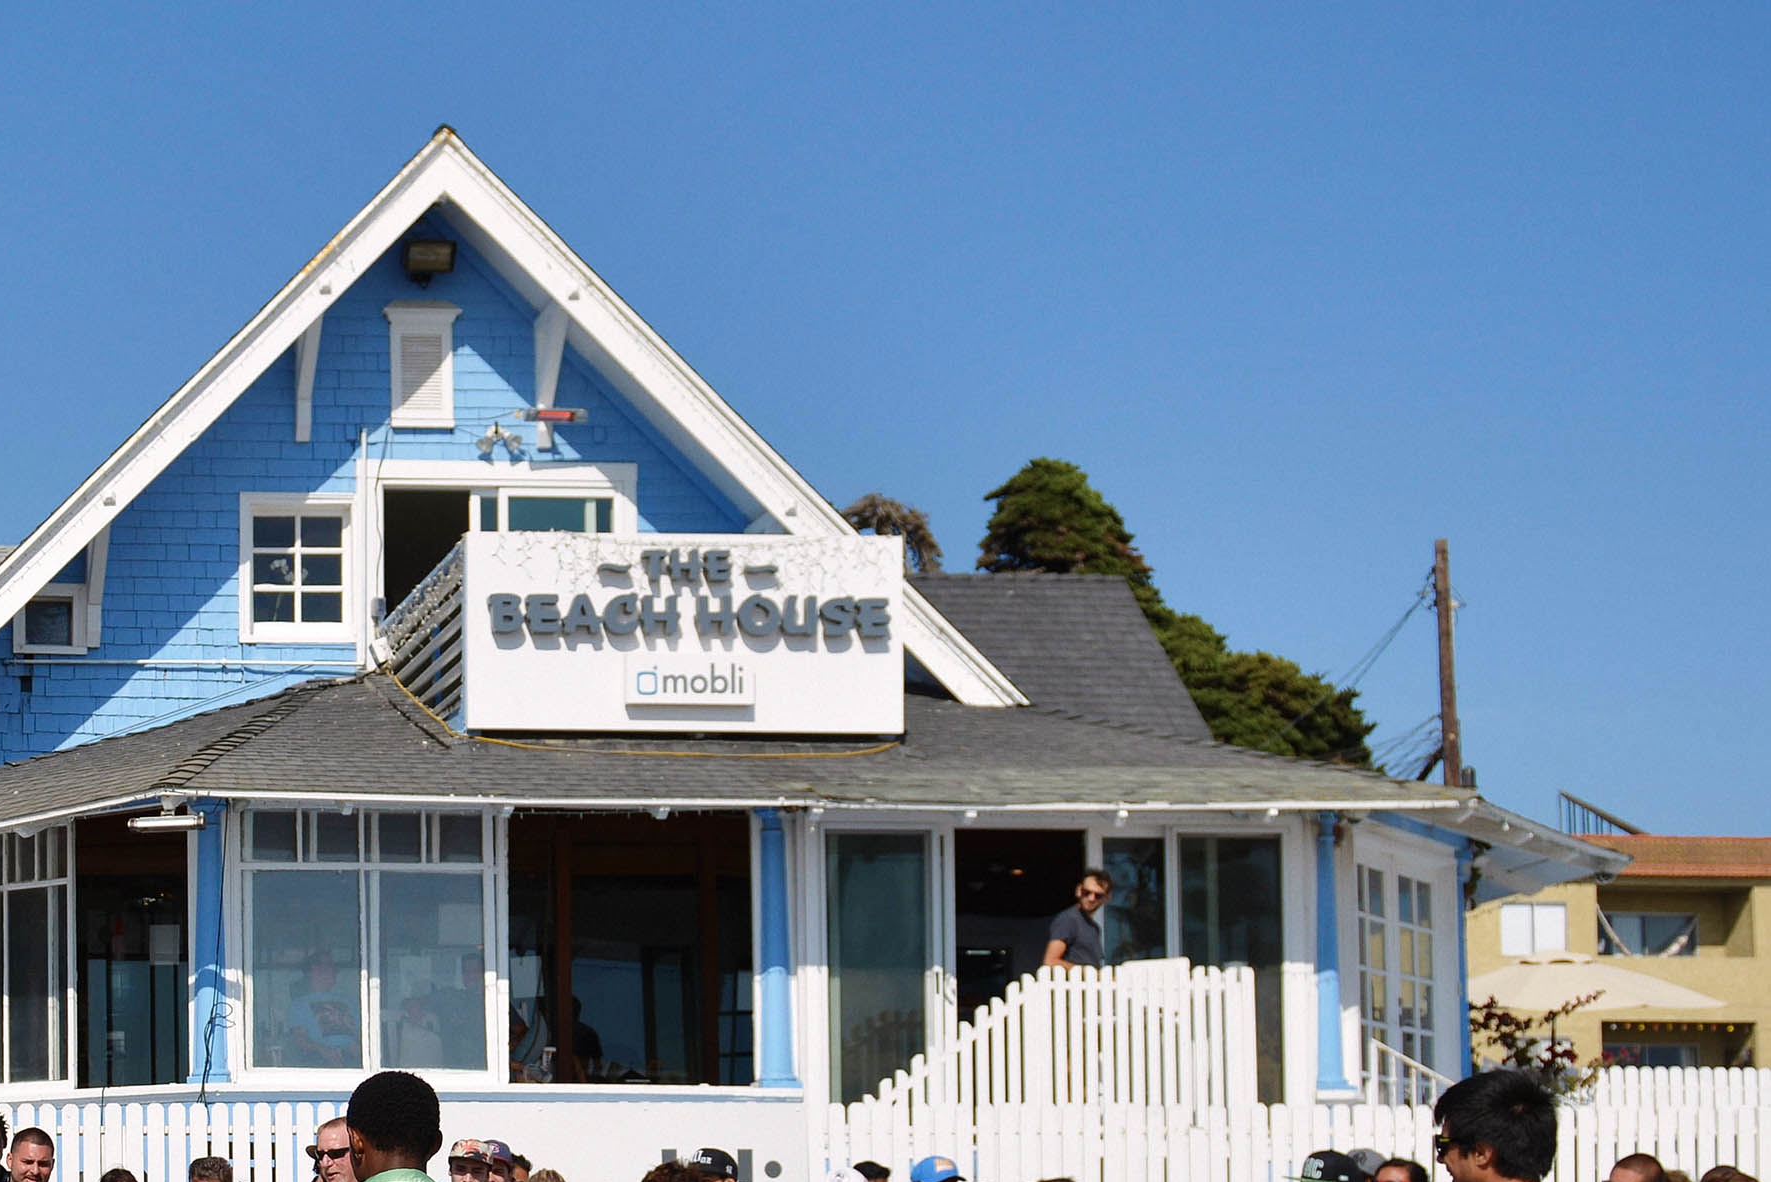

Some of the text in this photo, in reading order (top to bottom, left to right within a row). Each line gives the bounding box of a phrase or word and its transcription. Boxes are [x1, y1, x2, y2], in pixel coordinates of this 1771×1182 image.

[641, 549, 729, 583] THE
[489, 592, 890, 639] BEACH HOUSE
[663, 663, 744, 695] mobli
